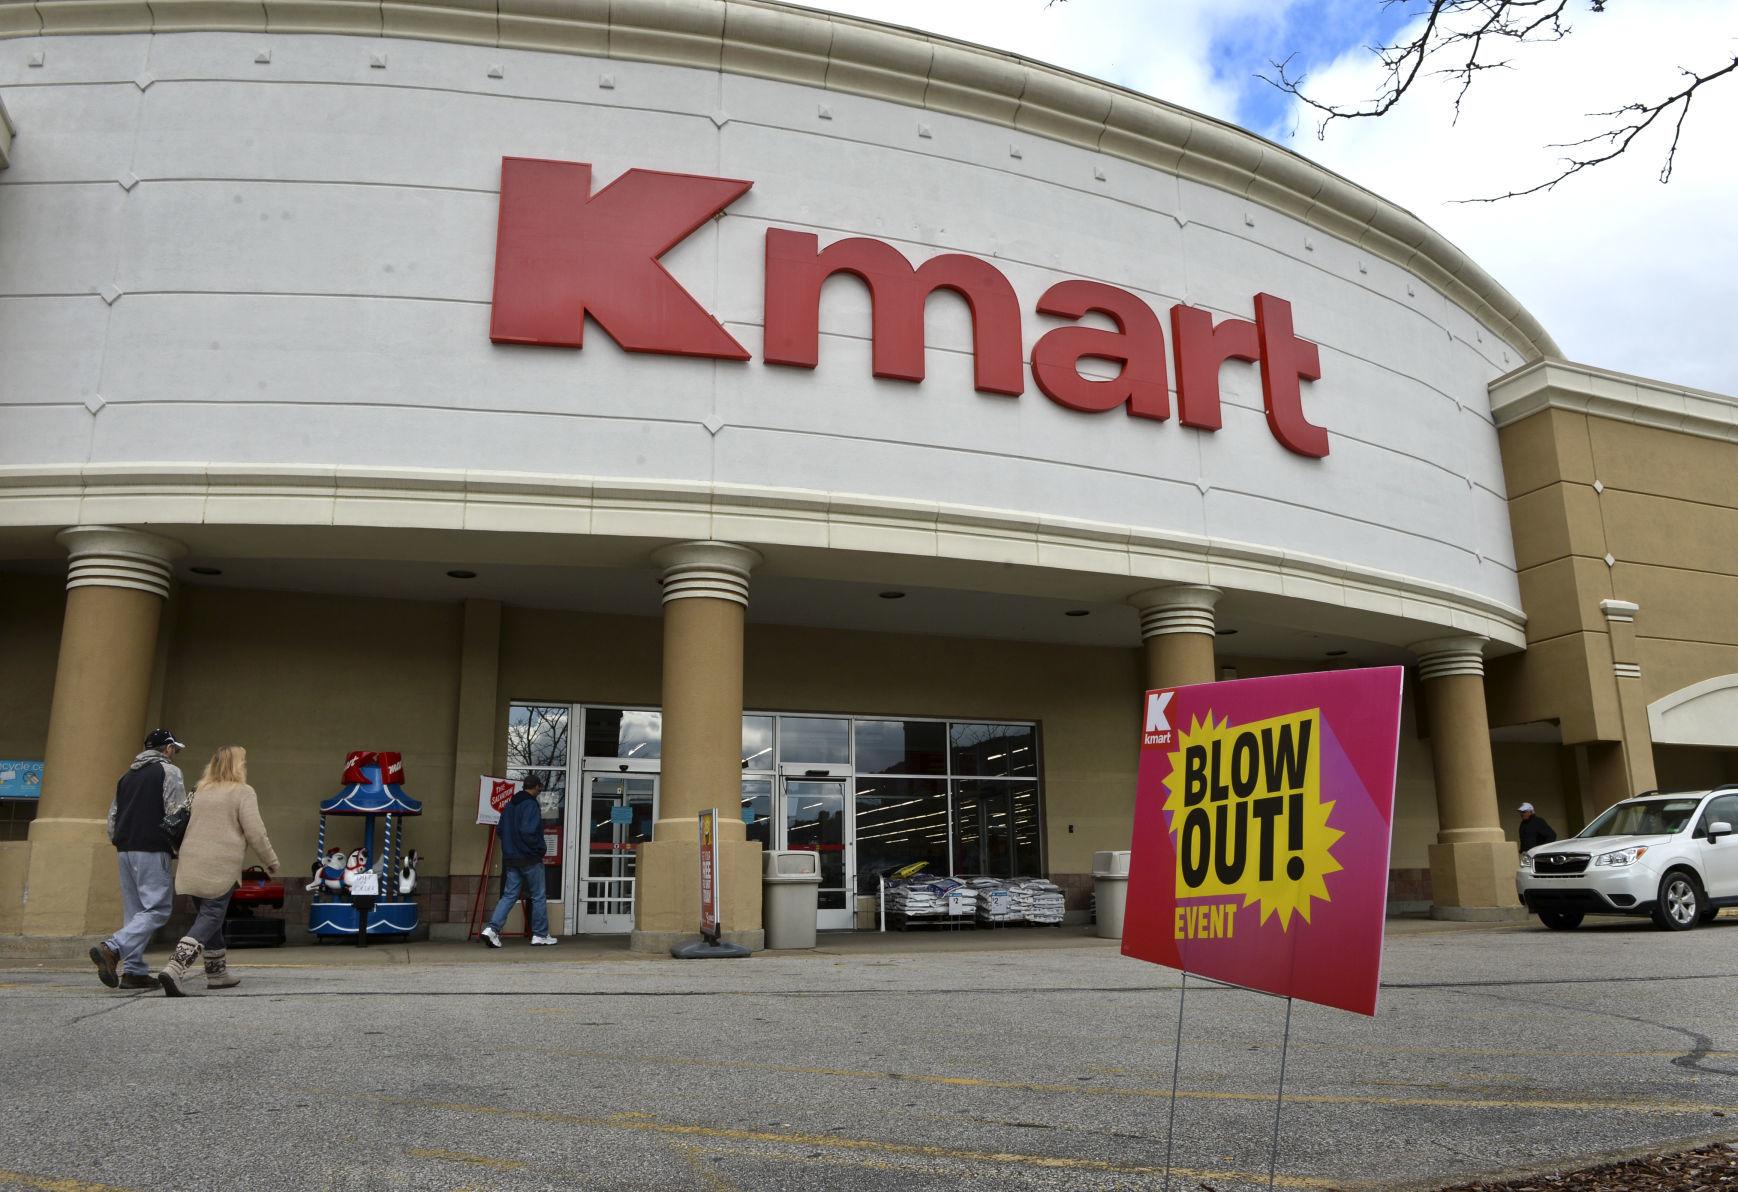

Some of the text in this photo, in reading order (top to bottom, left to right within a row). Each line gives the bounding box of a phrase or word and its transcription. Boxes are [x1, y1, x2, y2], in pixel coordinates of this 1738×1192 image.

[490, 156, 1330, 459] Kmart
[1144, 731, 1171, 745] kmart
[1184, 718, 1312, 808] BLOW
[1181, 793, 1305, 888] OUT!
[1174, 904, 1237, 940] EVENT
